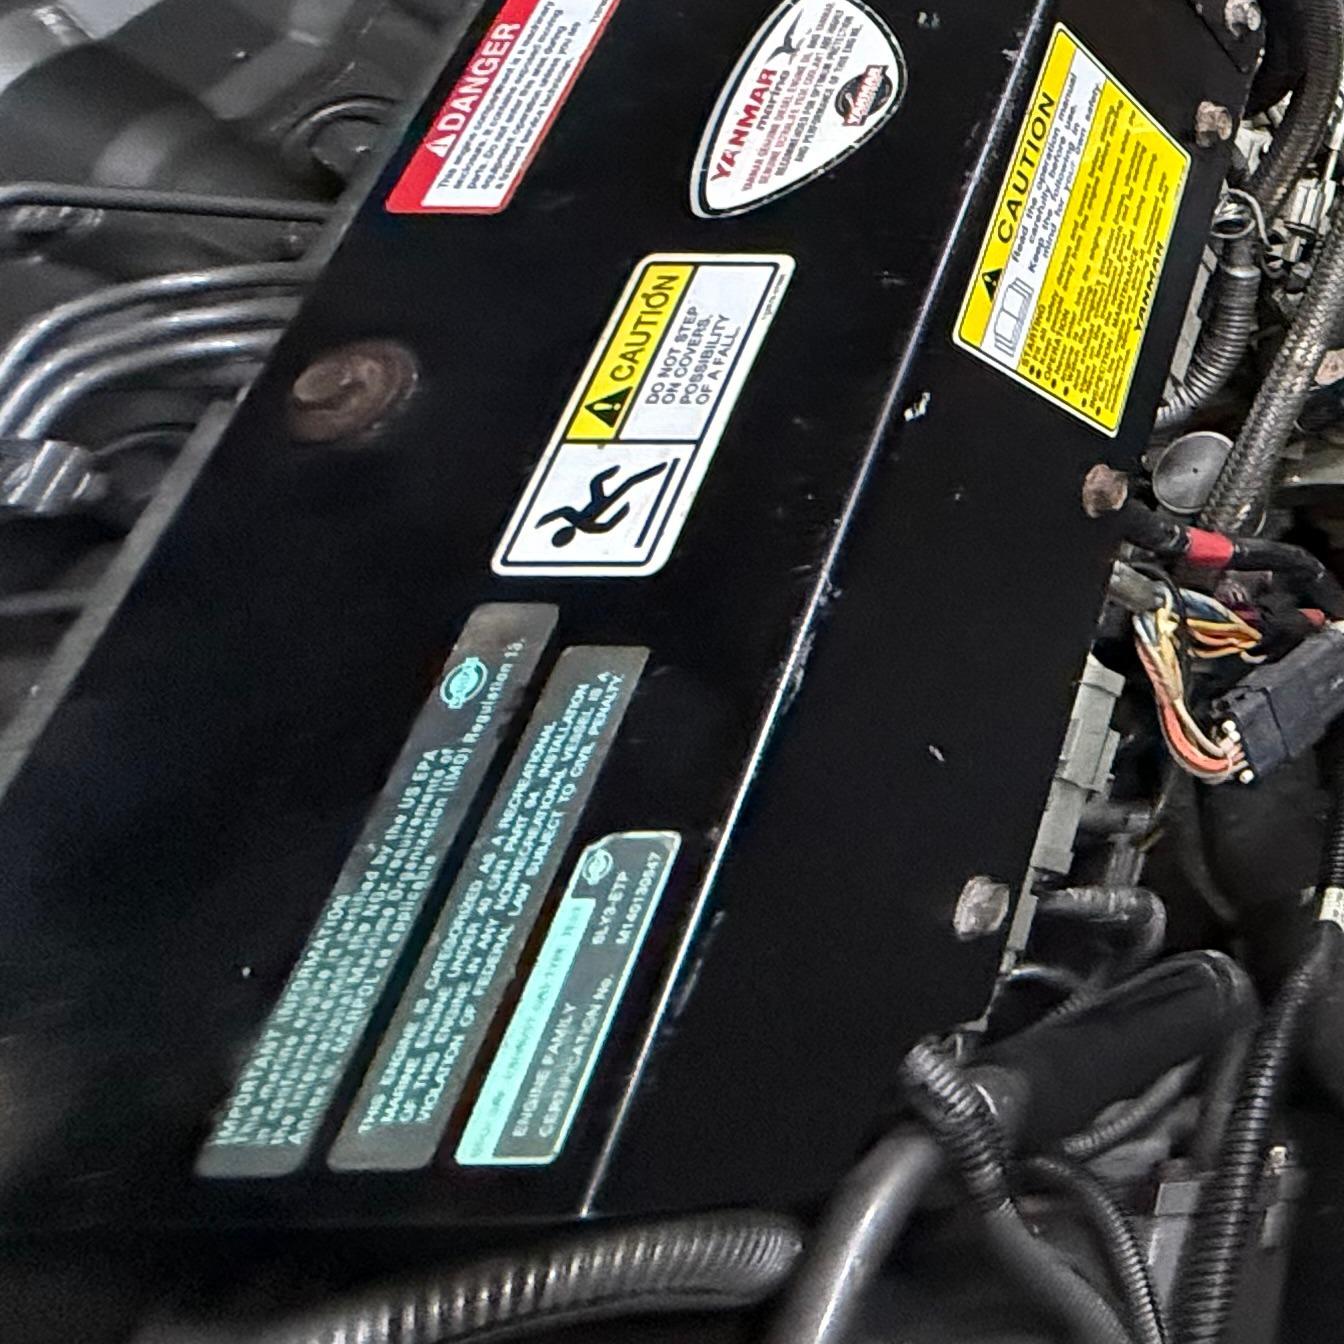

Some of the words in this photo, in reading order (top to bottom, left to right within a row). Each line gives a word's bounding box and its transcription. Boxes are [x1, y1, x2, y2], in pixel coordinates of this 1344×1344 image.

[436, 168, 457, 188] This
[453, 132, 476, 164] engine
[474, 67, 513, 130] compartment
[521, 1, 554, 46] machinery
[439, 23, 518, 130] DANGER
[709, 69, 777, 181] YANMAR
[755, 70, 789, 130] marine
[843, 64, 882, 130] YANMAR
[997, 93, 1054, 242] CAUTION
[1011, 224, 1028, 262] Read
[1025, 196, 1037, 219] the
[1036, 127, 1061, 194] operation
[1058, 72, 1076, 121] manual
[1027, 237, 1045, 273] Keep
[1041, 208, 1053, 230] the
[1050, 141, 1076, 201] following
[1071, 122, 1080, 135] in
[1028, 185, 1052, 243] carefully
[1048, 135, 1066, 178] before
[1064, 105, 1075, 129] use.
[1042, 222, 1056, 258] mind
[1054, 197, 1064, 217] for
[1063, 160, 1075, 194] your
[1074, 127, 1086, 154] own
[1084, 83, 1102, 121] safety.
[610, 275, 677, 381] CAUTION
[712, 327, 740, 365] FALL.
[1021, 304, 1045, 366] STARTING
[1043, 308, 1069, 380] OPERATION
[1089, 338, 1113, 408] INSPECTION
[1112, 248, 1138, 327] MAINTENANCE
[1133, 241, 1163, 330] YANMAR
[644, 382, 665, 404] DO
[657, 347, 680, 377] NOT
[674, 306, 697, 342] STEP
[661, 382, 681, 404] ON
[673, 315, 711, 378] COVERS.
[678, 314, 728, 404] POSSIBILITY
[694, 384, 712, 404] OF
[706, 370, 721, 379] A
[358, 1094, 385, 1133] THIS
[380, 1023, 418, 1085] ENGINE
[413, 997, 429, 1013] IS
[425, 880, 482, 989] CATEGORIZED
[478, 852, 496, 873] AS
[491, 835, 505, 845] A
[498, 722, 556, 828] RECREATIONAL
[380, 1058, 419, 1122] MARINE
[414, 988, 451, 1048] ENGINE
[447, 922, 480, 977] UNDER
[476, 897, 492, 915] 40
[503, 815, 528, 851] PART
[539, 683, 588, 777] INSTALLATION
[399, 1100, 416, 1122] OF
[412, 1051, 439, 1089] THIS
[434, 983, 470, 1043] ENGINE
[465, 956, 481, 973] IN
[477, 918, 498, 949] ANY
[561, 707, 594, 761] VESSEL
[588, 687, 603, 701] IS
[597, 671, 610, 682] A
[417, 1034, 463, 1121] VIOLATION
[459, 1004, 475, 1027] OF
[473, 925, 513, 995] FEDERAL
[508, 883, 530, 916] LAW
[525, 811, 562, 875] SUBJECT
[556, 783, 575, 802] TO
[569, 742, 595, 777] CIVIL
[217, 1030, 279, 1144] IMPORTANT
[277, 895, 348, 1022] INFORMATION
[512, 1069, 550, 1136] ENGINE
[541, 1003, 575, 1064] FAMILY
[539, 1004, 600, 1136] CERTIFICATION
